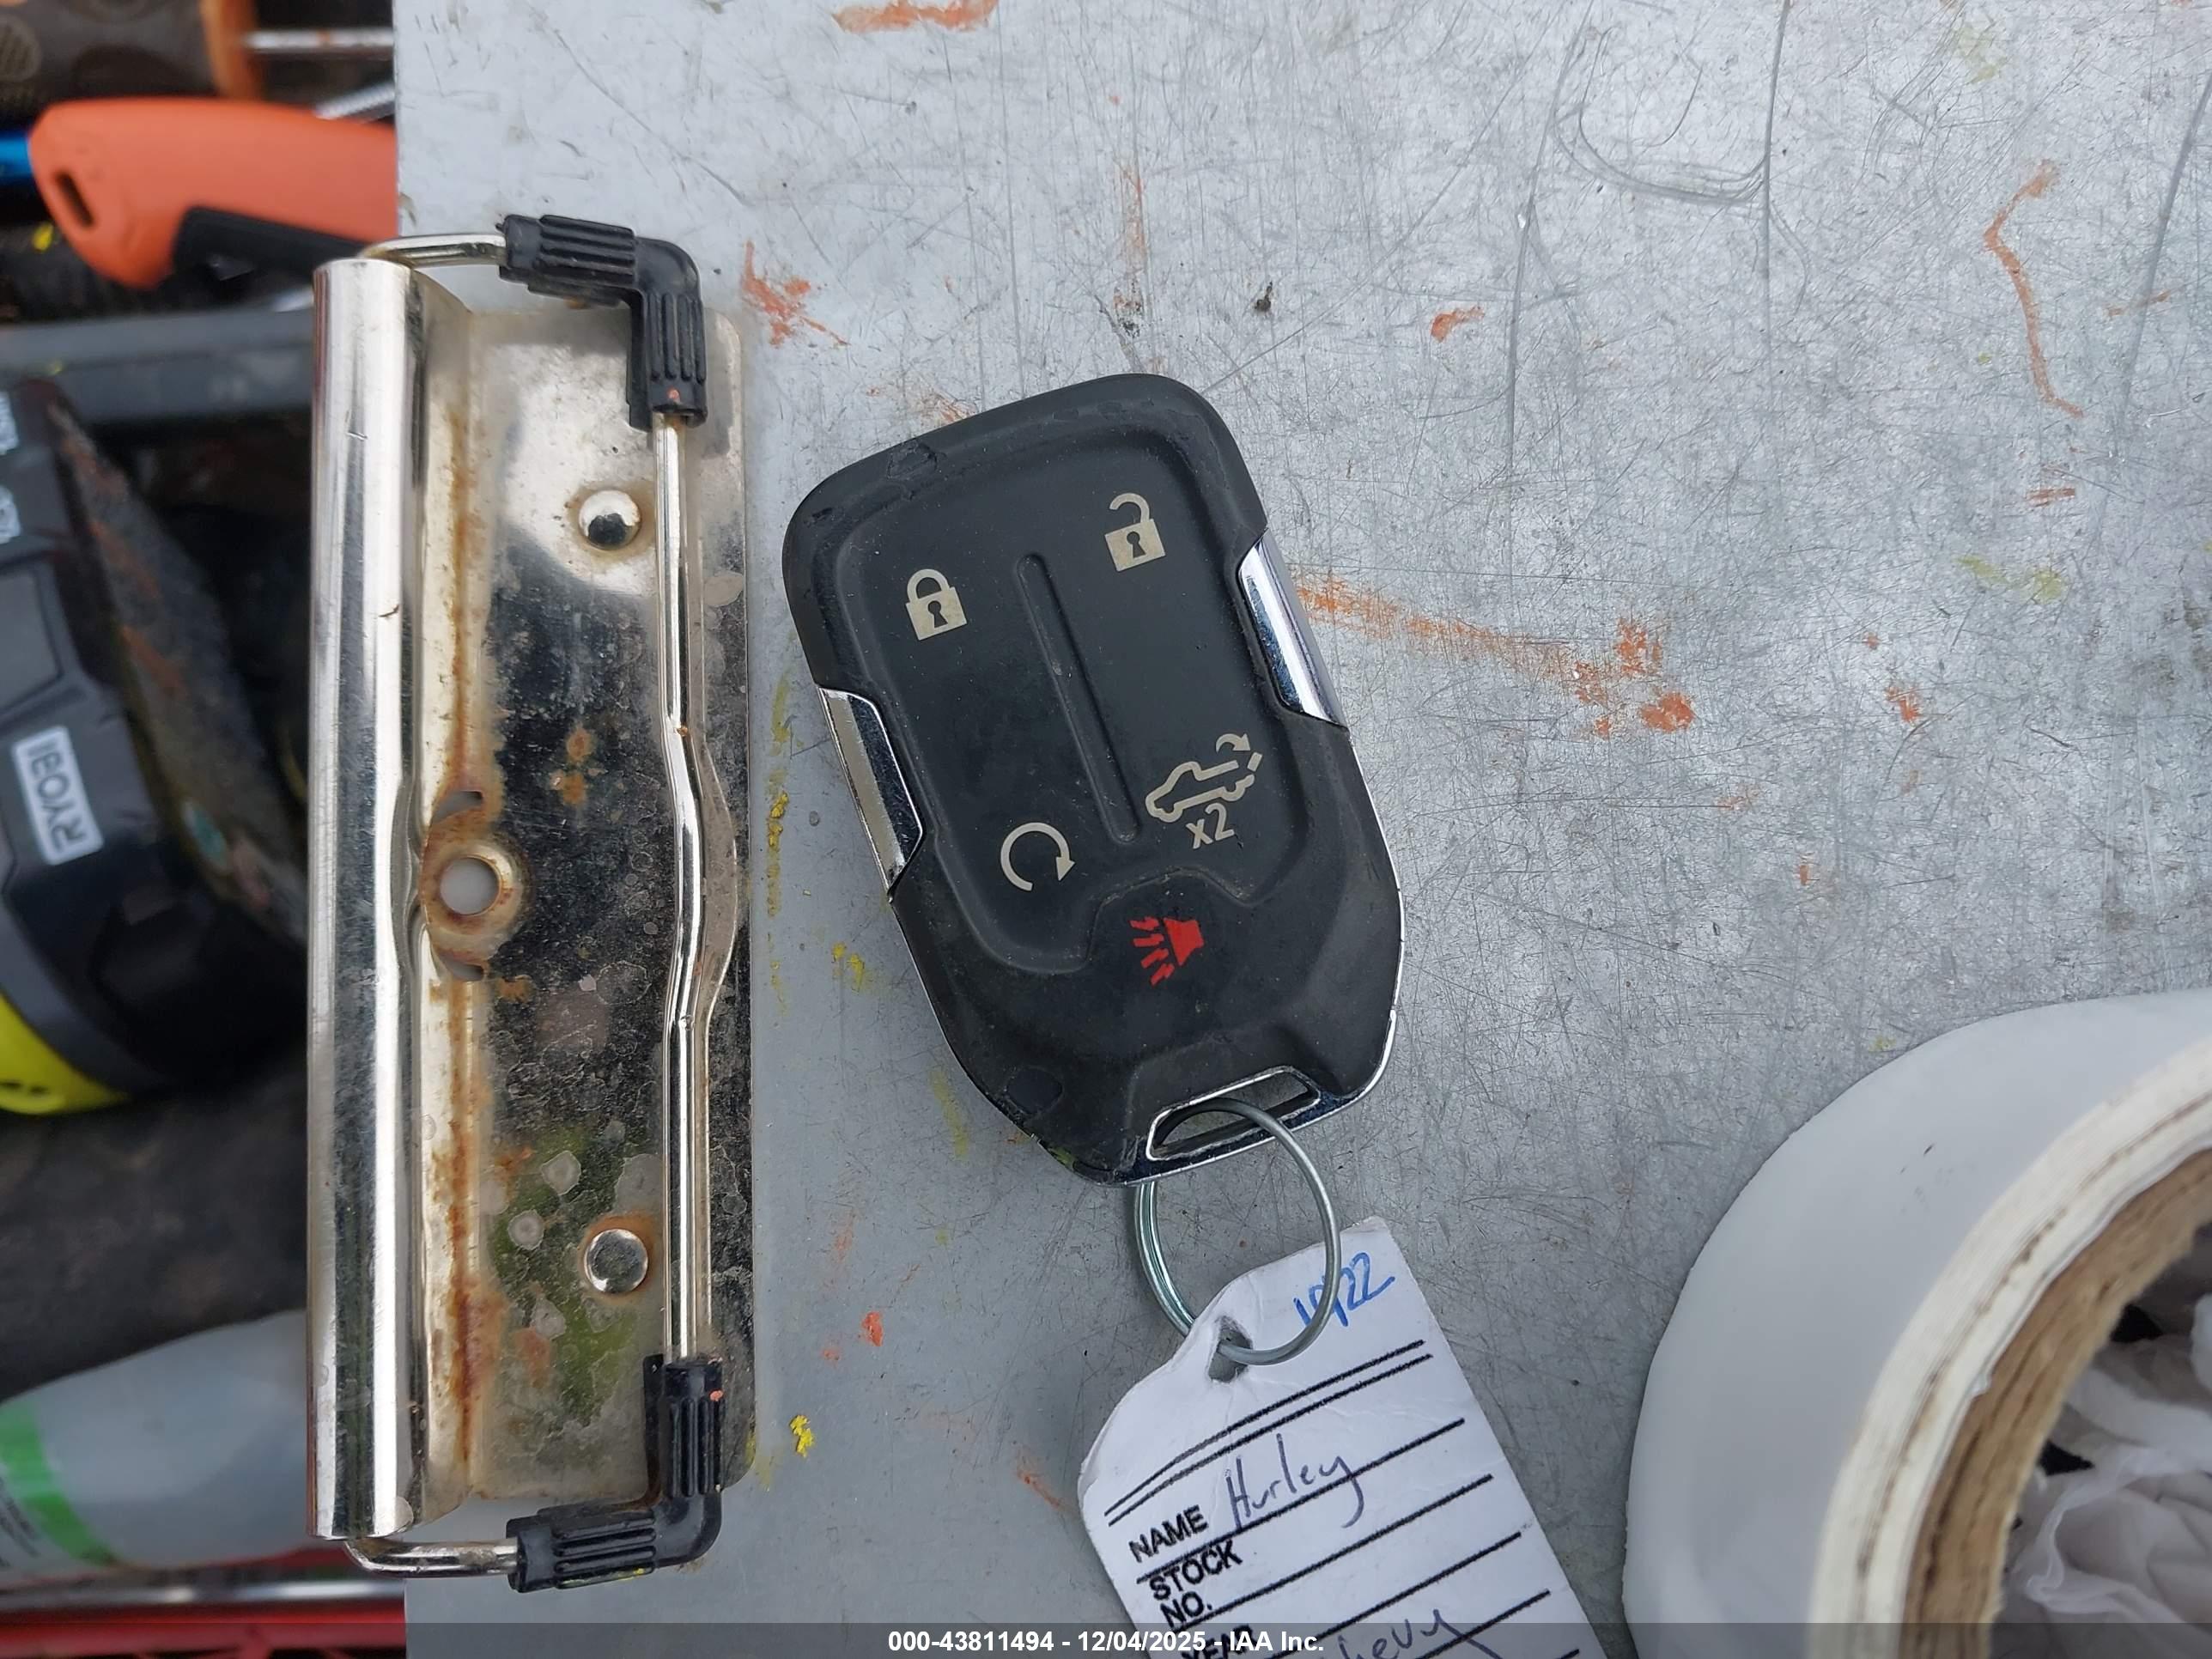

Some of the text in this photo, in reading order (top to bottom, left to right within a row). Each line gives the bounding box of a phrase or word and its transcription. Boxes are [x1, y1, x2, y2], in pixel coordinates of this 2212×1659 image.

[28, 740, 87, 852] RYOBI
[1186, 802, 1235, 849] x2
[1224, 1433, 1364, 1528] Hurley
[1128, 1504, 1208, 1563] NAME
[1149, 1540, 1243, 1601] STOCK
[1159, 1591, 1212, 1627] NO.
